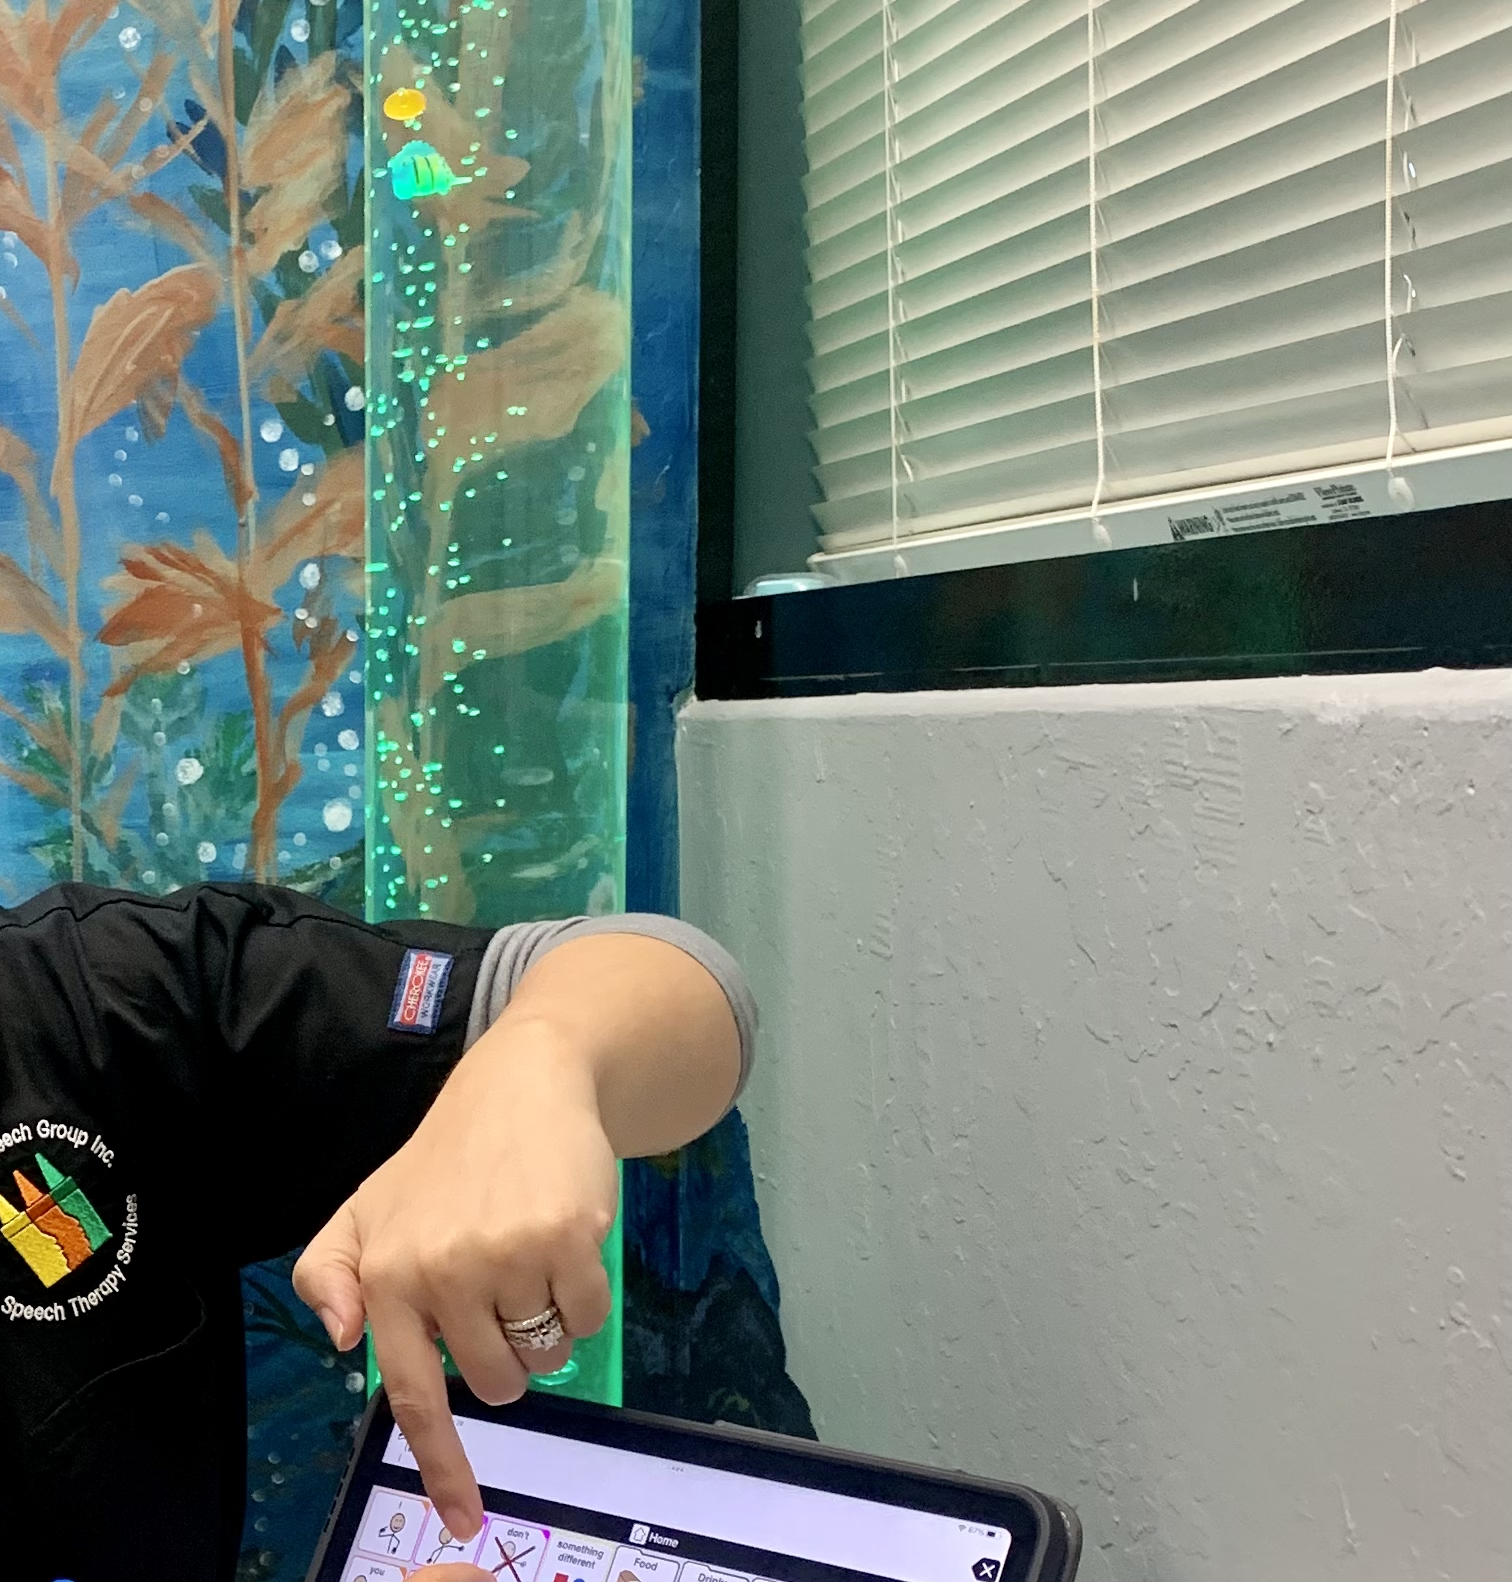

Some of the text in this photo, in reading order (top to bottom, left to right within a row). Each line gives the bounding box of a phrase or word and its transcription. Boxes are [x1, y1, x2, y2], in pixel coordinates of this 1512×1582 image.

[420, 963, 441, 1019] WORKWEAR
[37, 1119, 89, 1149] Group
[90, 1135, 115, 1168] Inc.
[1, 1193, 138, 1321] Speech Therapy Services
[507, 1528, 530, 1541] don't
[648, 1532, 679, 1548] Home
[557, 1541, 604, 1560] something
[557, 1553, 596, 1569] different
[633, 1558, 658, 1571] Food
[369, 1566, 385, 1576] you
